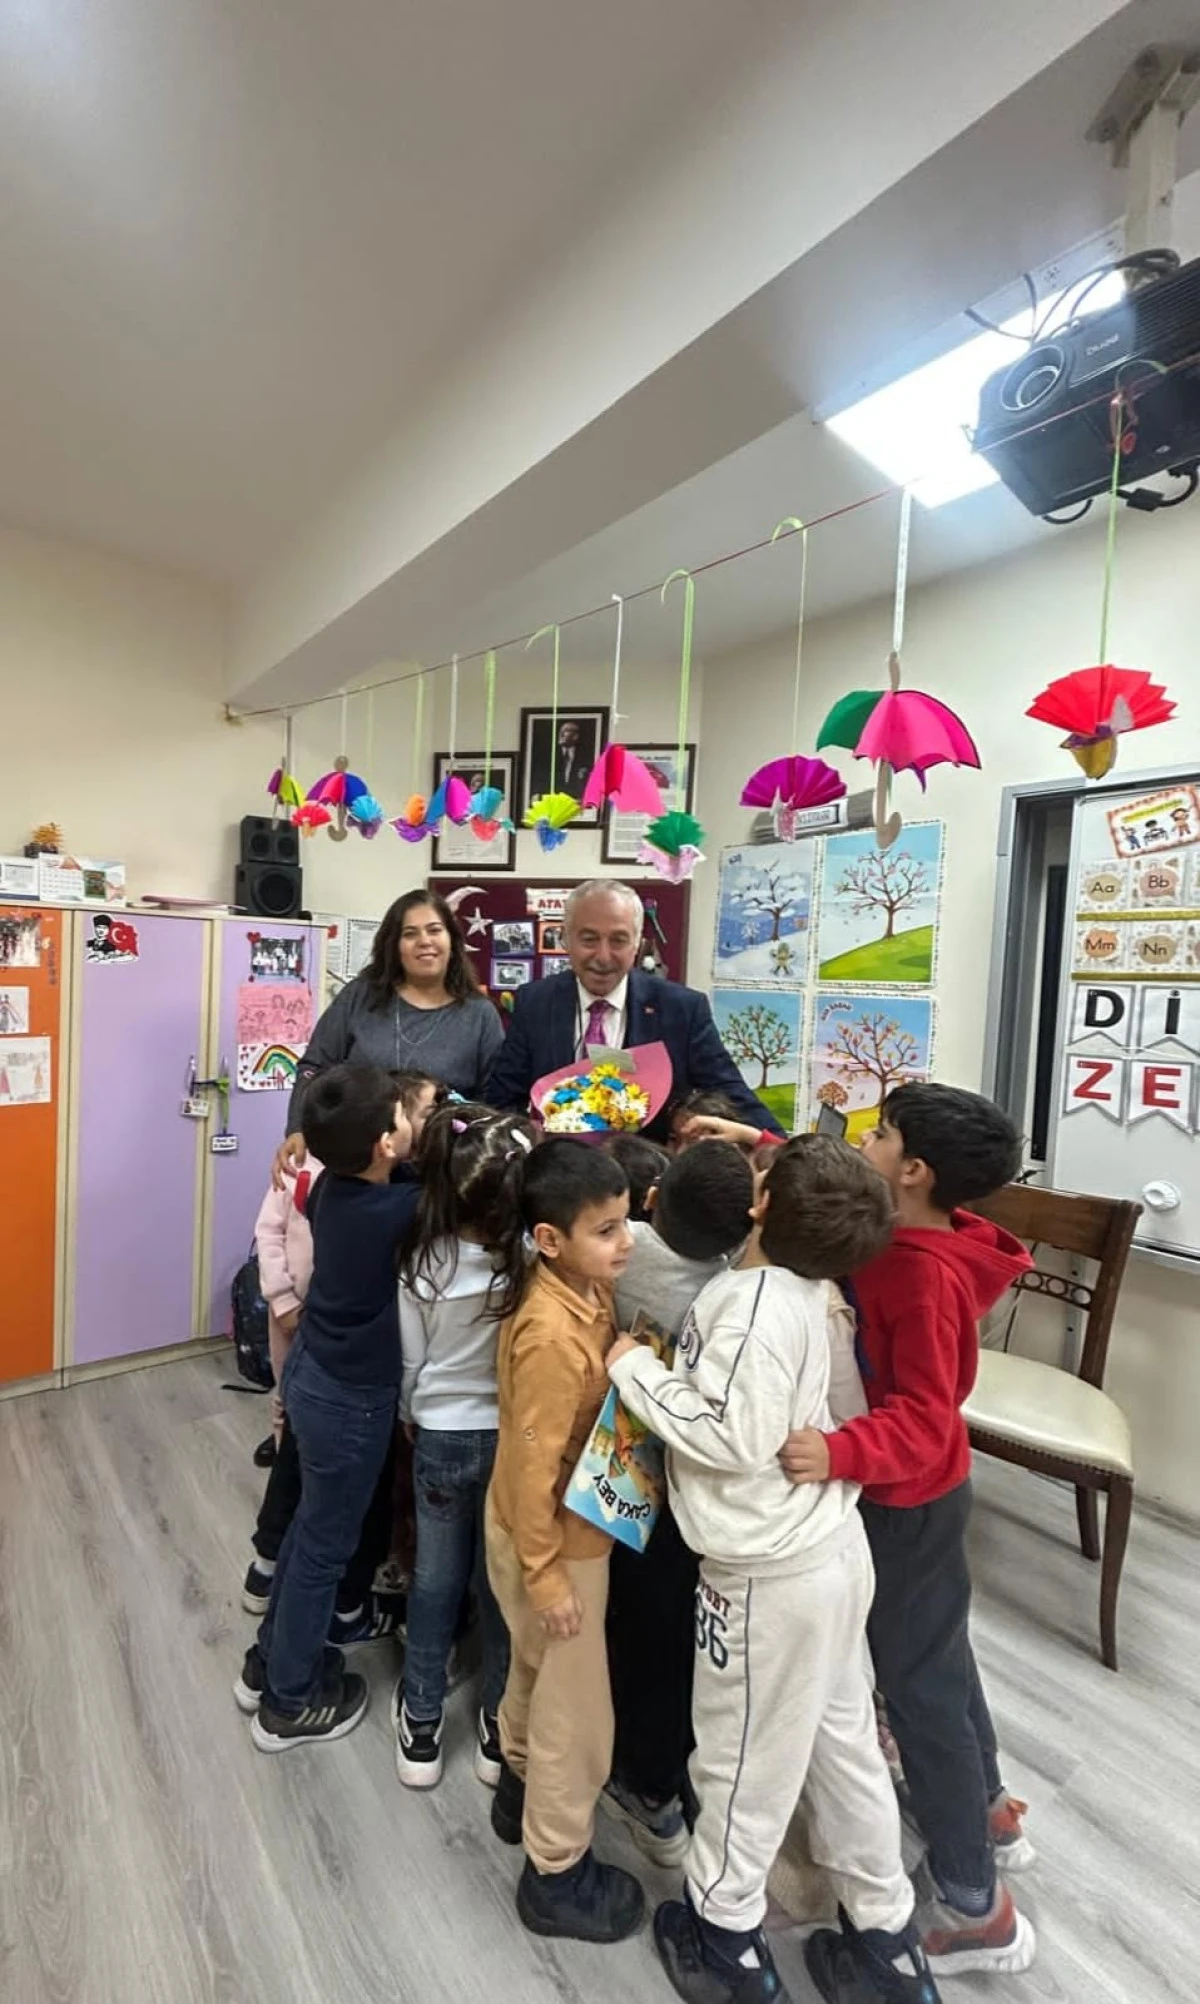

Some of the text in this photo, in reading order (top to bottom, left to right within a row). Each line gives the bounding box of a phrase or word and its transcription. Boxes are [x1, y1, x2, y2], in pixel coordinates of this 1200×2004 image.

[1091, 881, 1115, 893] Aa
[1148, 875, 1170, 889] Bb
[1085, 938, 1115, 951] Mm
[1143, 943, 1168, 956] Nn
[593, 1473, 618, 1508] BEY
